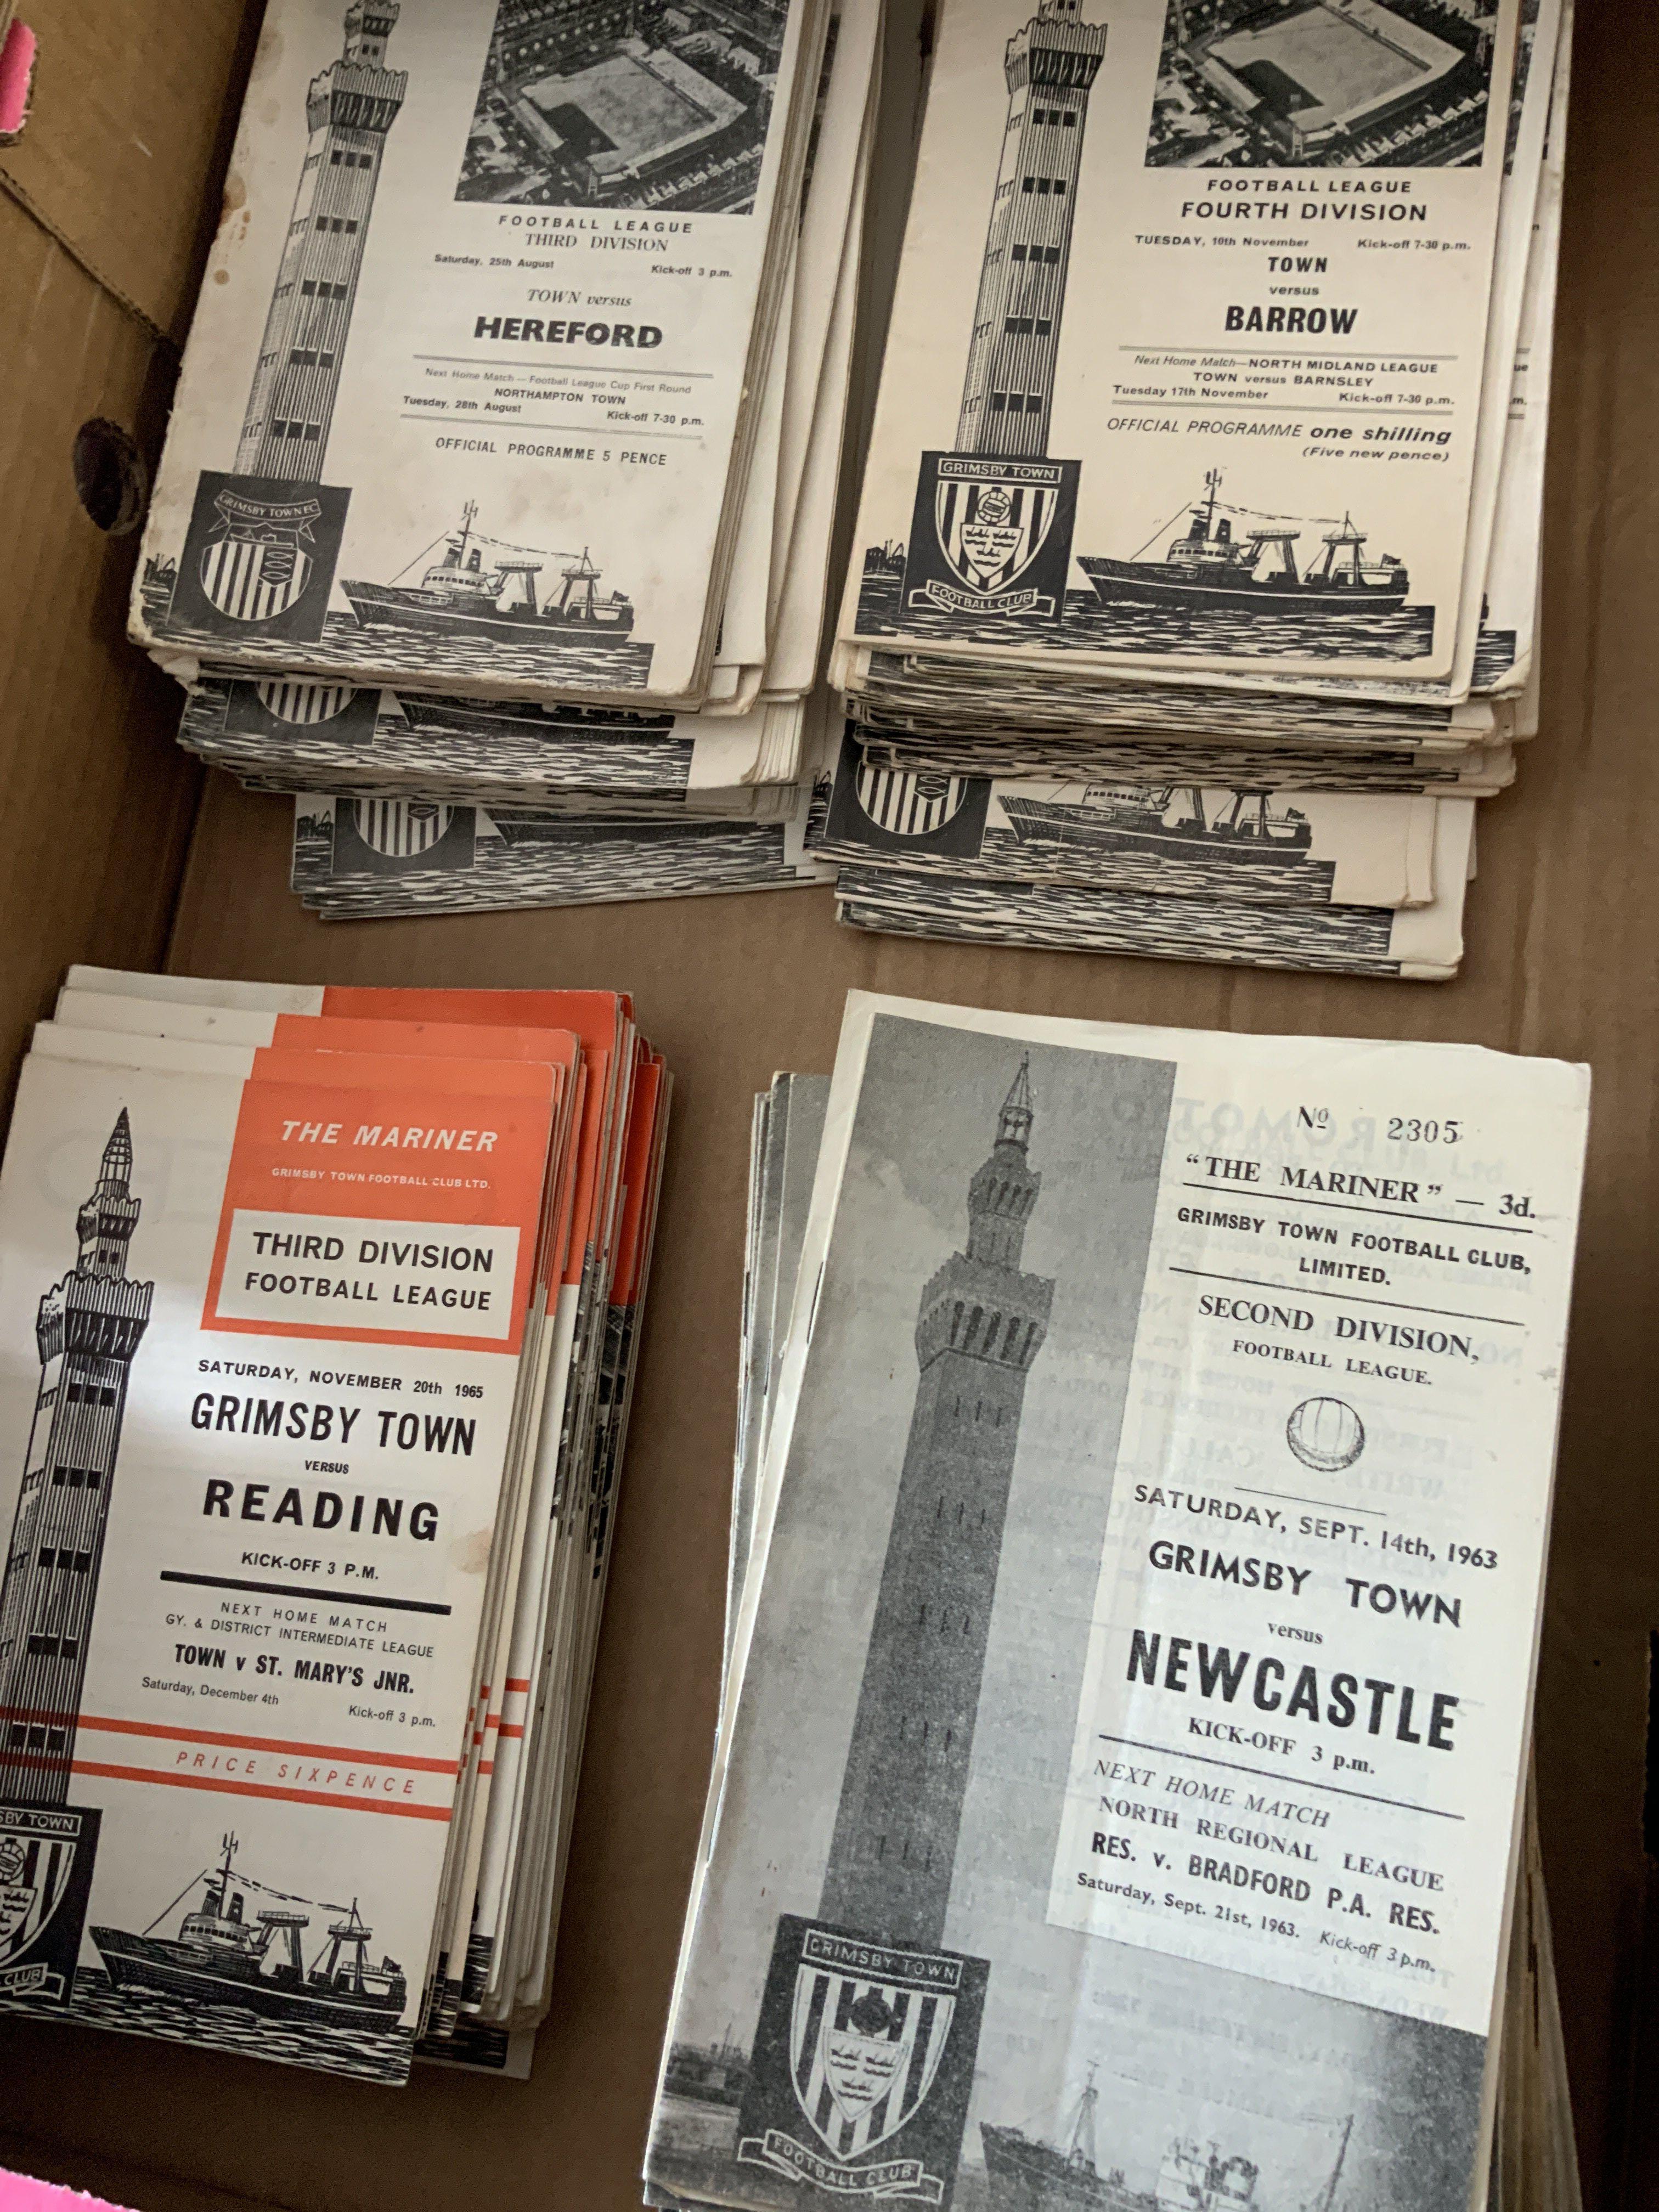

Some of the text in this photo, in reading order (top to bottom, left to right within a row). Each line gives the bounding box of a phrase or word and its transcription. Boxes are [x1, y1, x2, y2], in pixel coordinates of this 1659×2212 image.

[1208, 179, 1410, 193] FOOTBALL LEAGUE
[1182, 202, 1426, 221] FOURTH DIVISION
[499, 216, 691, 233] FOOTBALL LEAGUE
[527, 234, 666, 251] THIRD DIVISION
[1136, 235, 1308, 246] TUESDAY, 10th November
[1358, 240, 1438, 249] Kick-off 7-30
[435, 254, 554, 269] Saturday, 25th August
[652, 266, 692, 274] Kick-off
[1268, 257, 1327, 272] TOWN
[529, 290, 631, 306] TOWN versus
[1270, 287, 1319, 295] versus
[475, 317, 662, 348] HEREFORD
[1226, 306, 1357, 334] BARROW
[1135, 356, 1437, 373] Next Home MIDLAND LEAGUE
[426, 368, 691, 393] Next Home Match Football League Cup First Round
[1113, 385, 1268, 398] Tuesday 17th November
[1194, 373, 1237, 382] TOWN
[1294, 375, 1373, 386] BARNSLEY
[404, 396, 521, 413] Tuesday, 28th August
[495, 388, 625, 404] NORTHAMPTON TOWN
[1339, 393, 1421, 403] Kick-off 7-30
[607, 411, 648, 421] Kick-off
[654, 414, 675, 424] 7-30
[1108, 418, 1451, 444] OFFICIAL PROGRAMME one shilling
[436, 437, 667, 465] OFFICIAL PROGRAMME 5 PENCE
[1303, 447, 1344, 456] (Five
[1389, 452, 1449, 461] pence)
[943, 462, 1054, 478] GRIMSBY TOWN
[217, 495, 302, 517] GRIMSBY TOWN
[933, 586, 1032, 608] FOOTBALL CLUB
[283, 1121, 498, 1152] THE MARINER
[1388, 1118, 1463, 1143] 2305
[272, 1168, 490, 1188] GRIMSBY TOWN FOOTBALL CLUB LTD.
[1499, 1194, 1536, 1218] 3d.
[253, 1232, 493, 1272] THIRD DIVISION
[1178, 1207, 1530, 1274] GRIMSBY TOWN FOOTBALL CLUB,
[1300, 1257, 1390, 1285] LIMITED.
[245, 1272, 491, 1310] FOOTBALL LEAGUE
[1199, 1295, 1313, 1330] SECOND
[1336, 1317, 1479, 1364] DIVISION,
[1233, 1340, 1431, 1385] FOOTBALL LEAGUE.
[199, 1360, 483, 1398] SATURDAY, NOVEMBER 20th 1965
[191, 1393, 476, 1455] GRIMSBY TOWN
[306, 1460, 348, 1474] VERSUS
[203, 1480, 438, 1541] READING
[1135, 1485, 1497, 1568] SATURDAY, SEPT. 14th, 1963
[241, 1552, 378, 1579] KICK-OFF 3 P.M.
[1149, 1541, 1460, 1627] GRIMSBY TOWN
[221, 1602, 386, 1632] NEXT HOME MATCH
[166, 1614, 433, 1657] GY. DISTRICT INTERMEDIATE LEAGUE
[1268, 1623, 1322, 1644] versus
[176, 1644, 225, 1668] TOWN
[256, 1655, 281, 1675] ST.
[374, 1671, 413, 1693] JNR.
[142, 1677, 278, 1705] Saturday, December 4th
[1127, 1629, 1459, 1751] NEWCASTLE
[349, 1705, 435, 1726] Kick-off p.m.
[1189, 1718, 1374, 1774] KICK-OFF p.m.
[177, 1752, 414, 1793] PRICE SIXPENCE
[1094, 1760, 1330, 1827] NEXT HOME MATCH
[1099, 1796, 1443, 1891] NORTH REGIONAL LEAGUE
[1092, 1832, 1439, 1934] RES. BRADFORD P.A. RES.
[1077, 1872, 1299, 1938] Saturday, Sept. 21st, 1963.
[1319, 1931, 1381, 1959] Kick-off
[904, 1960, 956, 1980] TOWN
[773, 2135, 913, 2186] FOOTBALL CLUB
